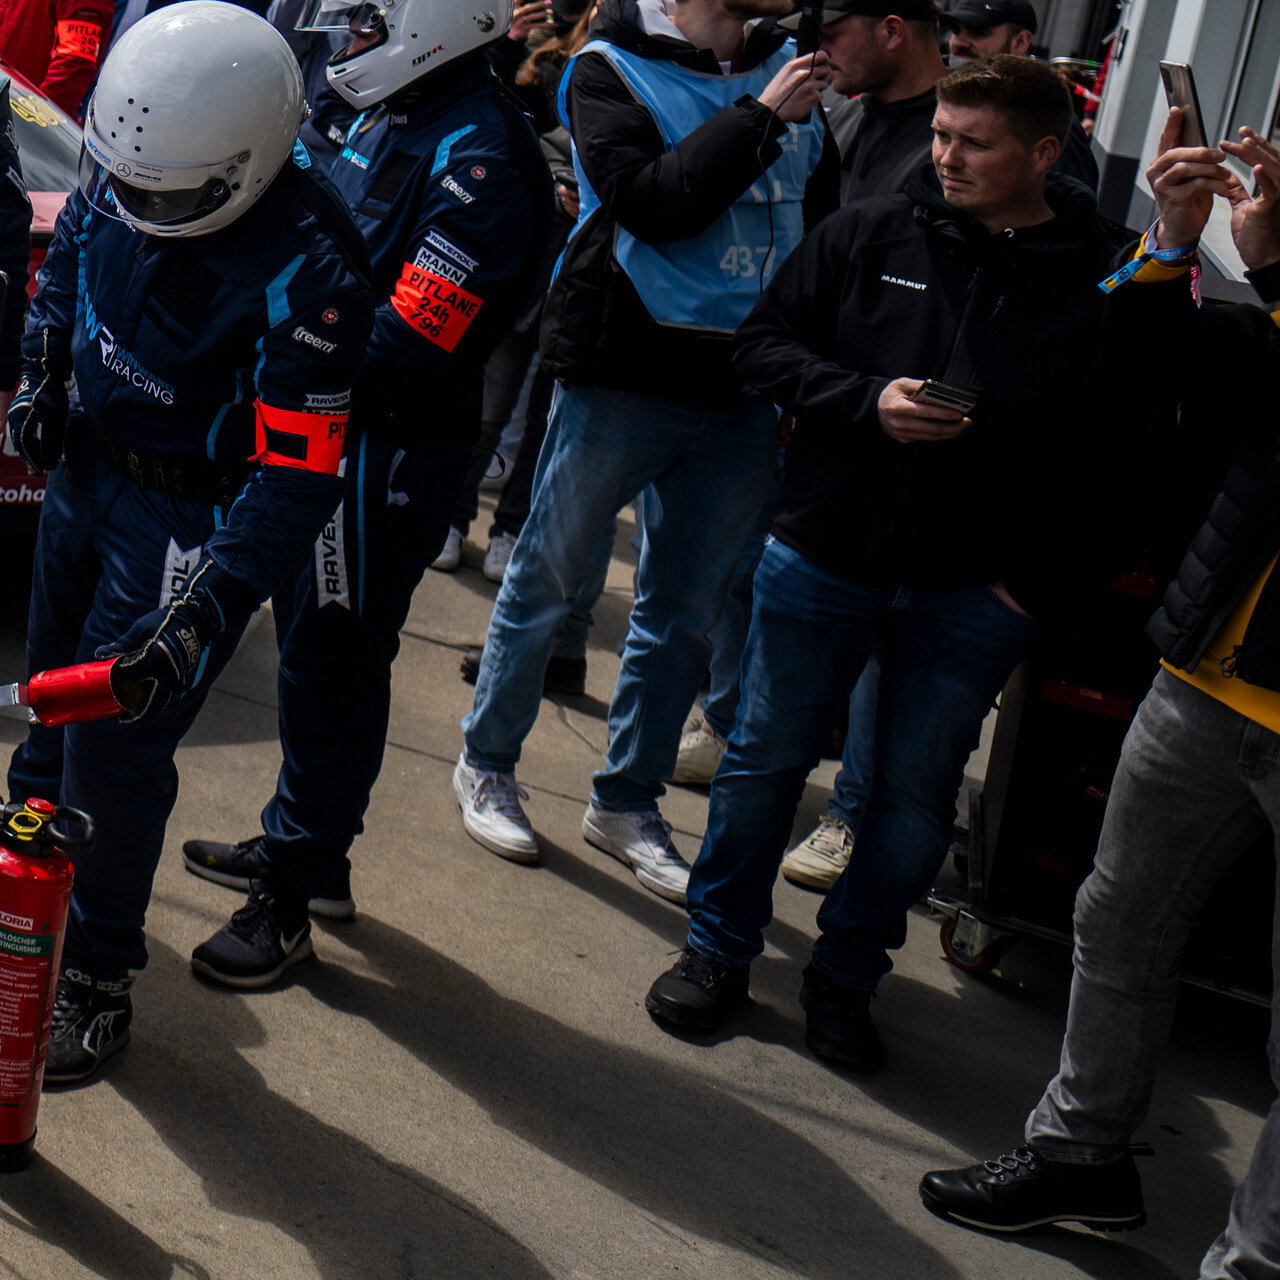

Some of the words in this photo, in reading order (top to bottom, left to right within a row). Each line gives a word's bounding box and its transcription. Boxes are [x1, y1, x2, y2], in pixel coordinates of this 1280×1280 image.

[441, 175, 476, 205] freem
[431, 235, 474, 266] RAVENOL
[719, 244, 778, 277] 437
[421, 251, 464, 282] MANN
[410, 271, 479, 318] PITLANE
[881, 275, 928, 291] MAMMUT
[409, 308, 441, 338] 796
[421, 297, 451, 325] 24h
[292, 325, 338, 354] freem
[111, 360, 175, 405] RACING
